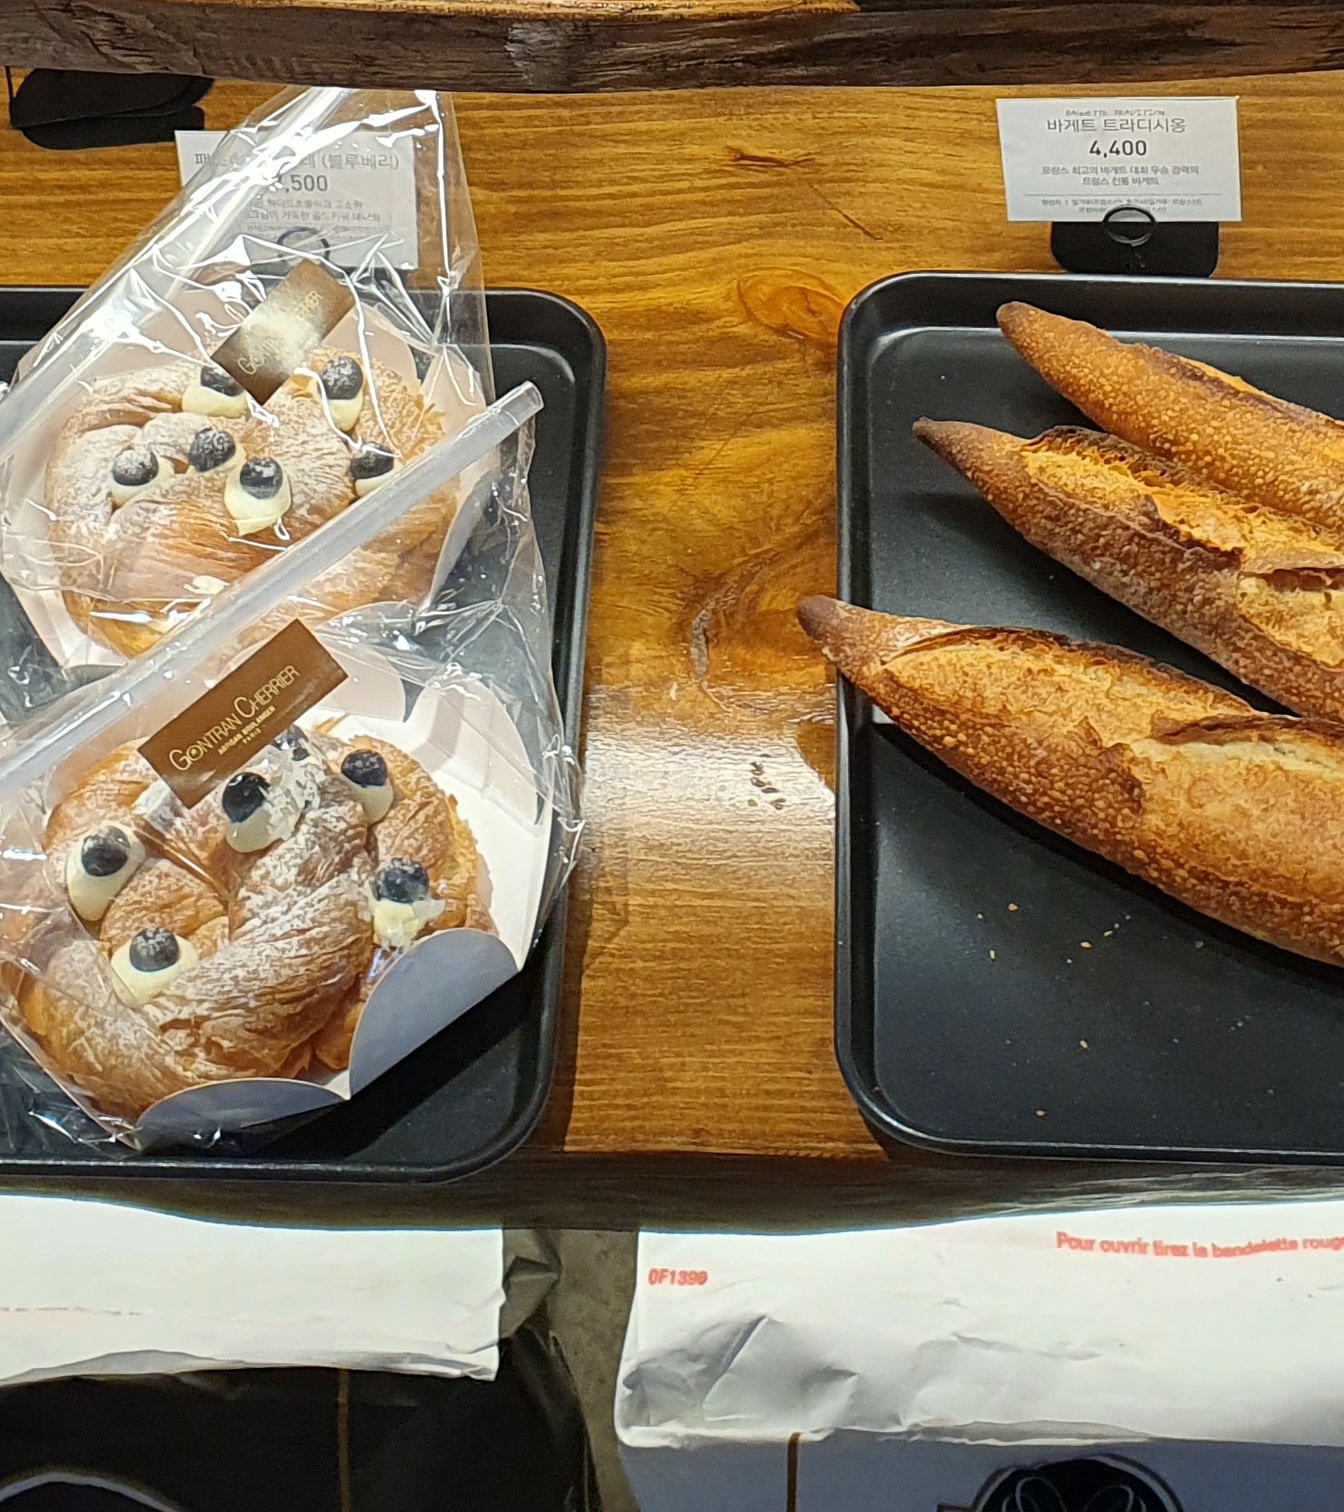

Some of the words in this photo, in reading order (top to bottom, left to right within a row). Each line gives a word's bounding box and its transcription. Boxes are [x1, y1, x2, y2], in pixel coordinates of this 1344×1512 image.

[1047, 119, 1097, 133] 바게트
[1102, 118, 1186, 133] 트라디시옹
[1089, 140, 1147, 158] 4,400
[322, 153, 400, 169] (블루베리)
[277, 175, 328, 193] ,500
[169, 713, 243, 771] GONTRAN
[234, 665, 301, 718] CHERRIER
[1056, 1231, 1095, 1251] Pour
[1099, 1237, 1149, 1255] ouvrir
